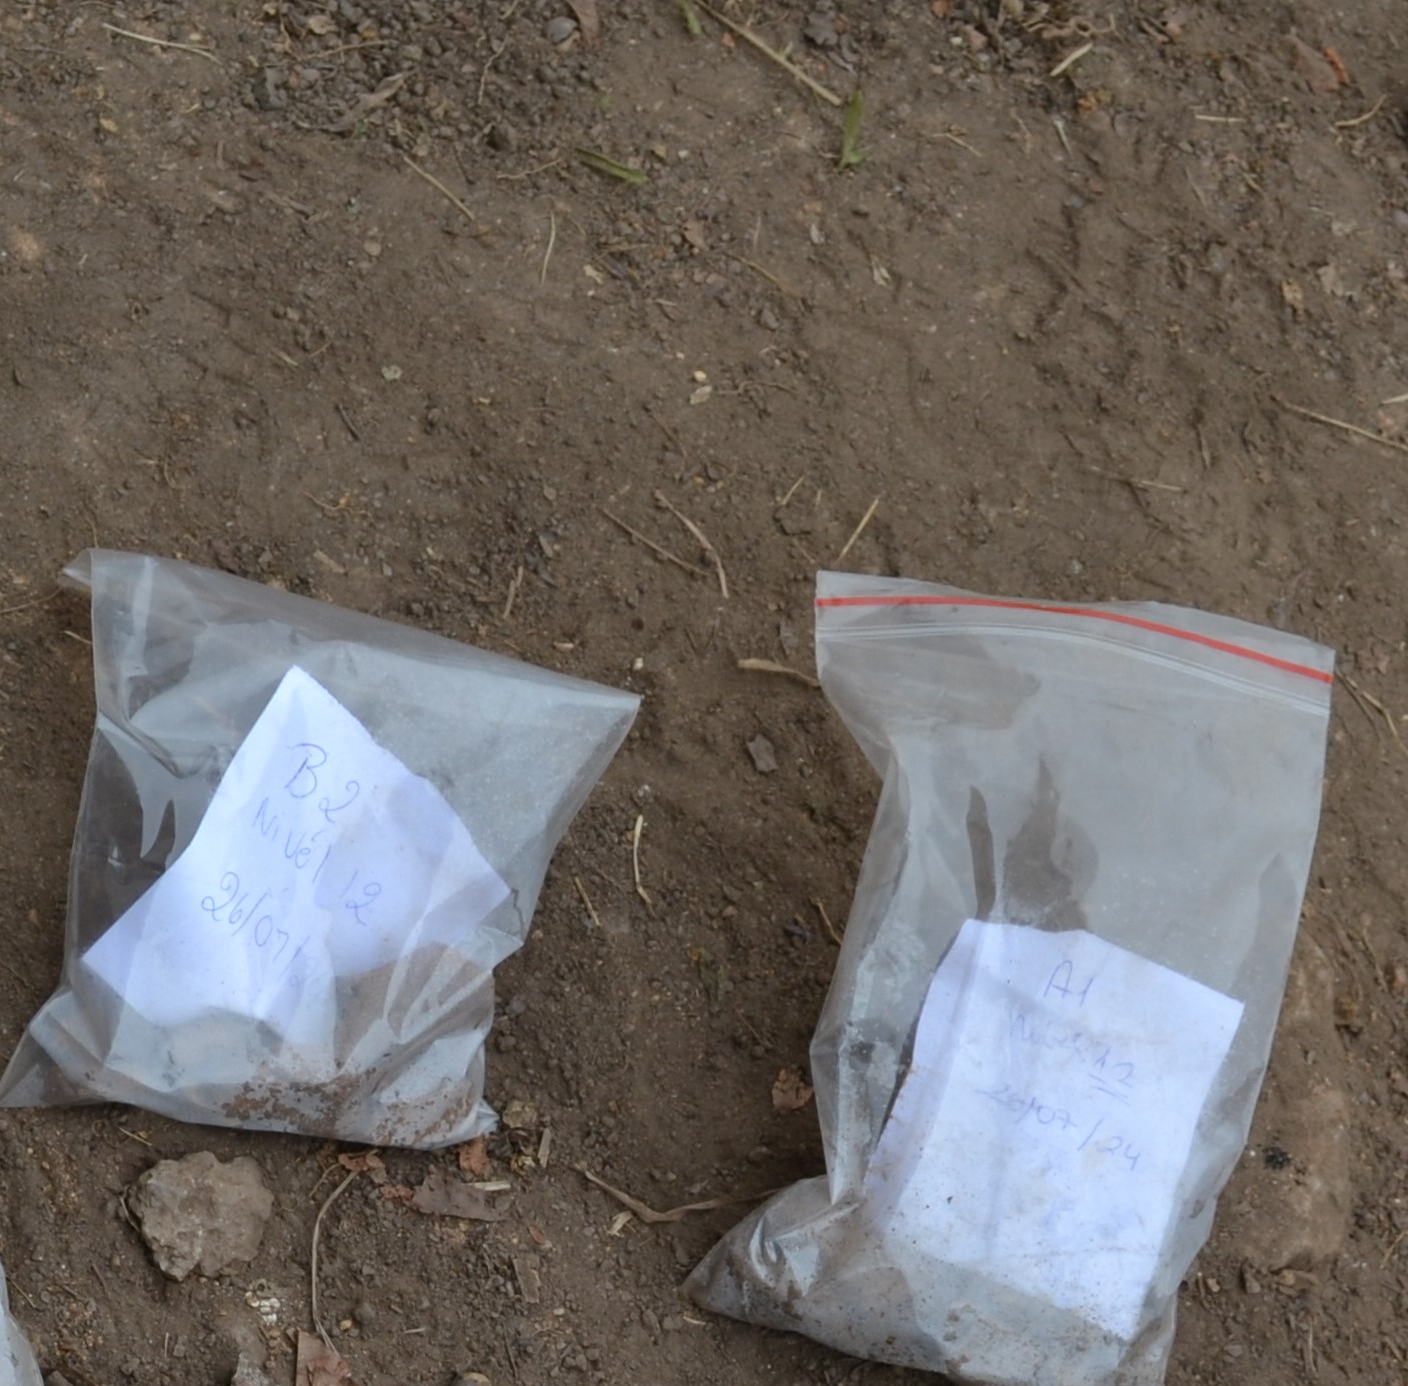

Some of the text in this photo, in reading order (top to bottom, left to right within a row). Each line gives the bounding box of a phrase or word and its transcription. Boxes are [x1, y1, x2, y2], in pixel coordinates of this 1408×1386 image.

[341, 870, 382, 926] 12
[1043, 959, 1094, 1007] A1
[1093, 1046, 1136, 1089] 12
